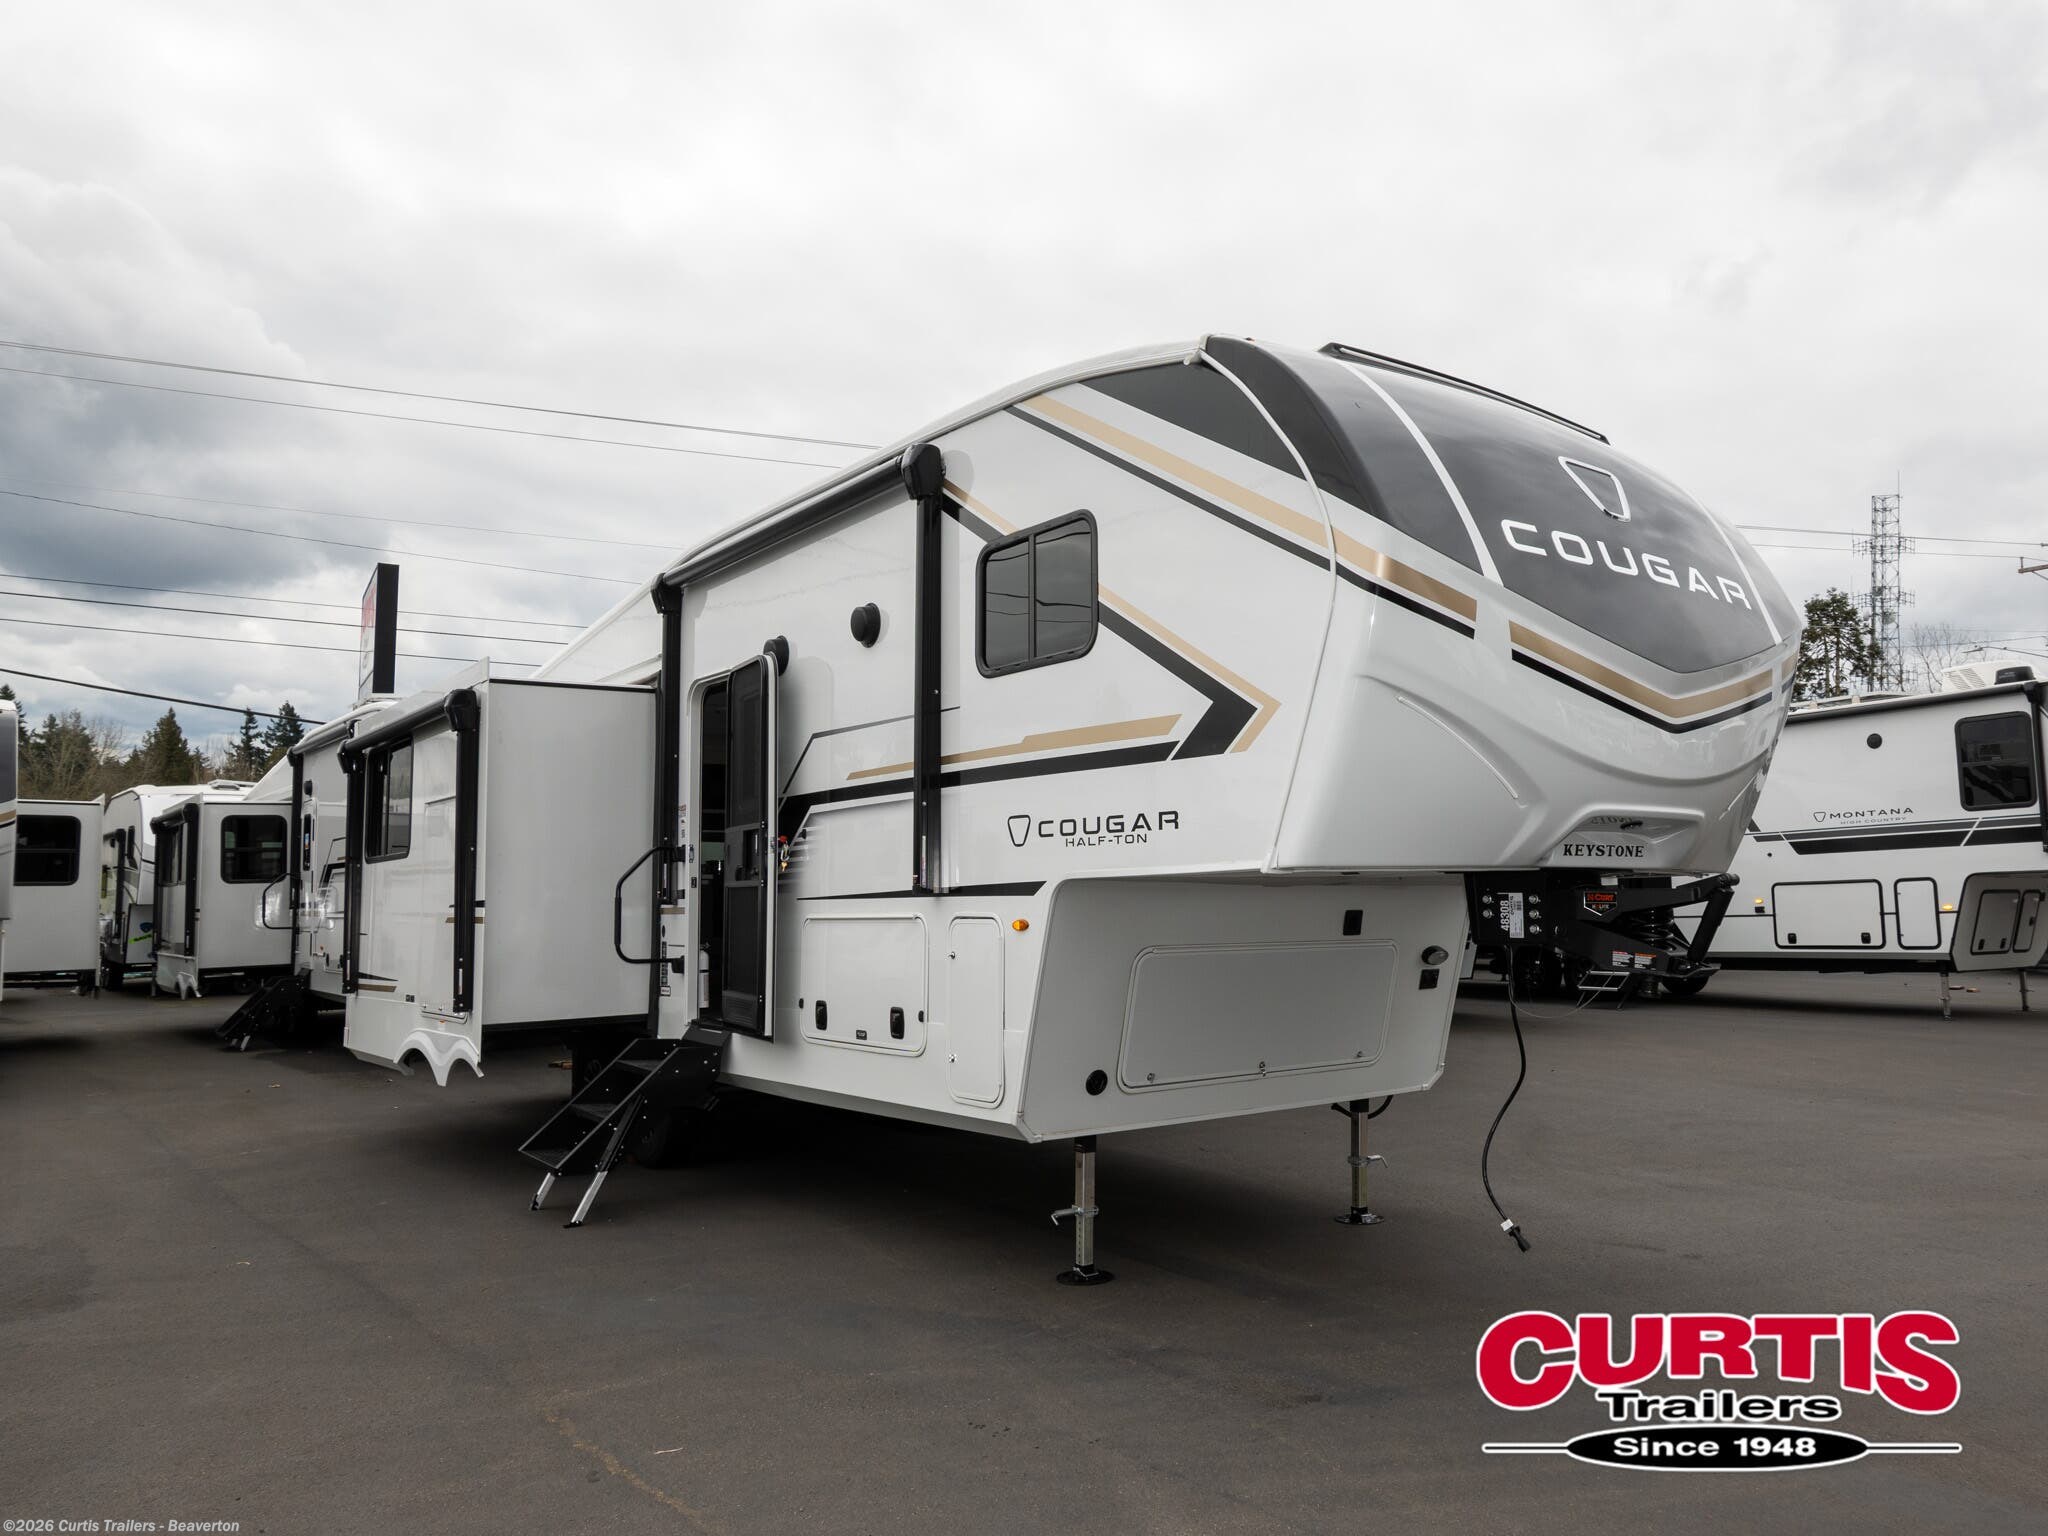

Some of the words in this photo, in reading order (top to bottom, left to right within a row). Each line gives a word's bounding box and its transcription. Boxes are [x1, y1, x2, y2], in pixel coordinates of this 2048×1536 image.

[1501, 519, 1752, 610] COUGAR
[1829, 807, 1914, 819] MONTANA
[1864, 816, 1907, 824] COUNTRY
[1037, 810, 1180, 838] COUGAR
[1065, 832, 1149, 847] HALF-TON
[1562, 843, 1645, 858] KEYSTONE
[1500, 900, 1510, 931] 48308
